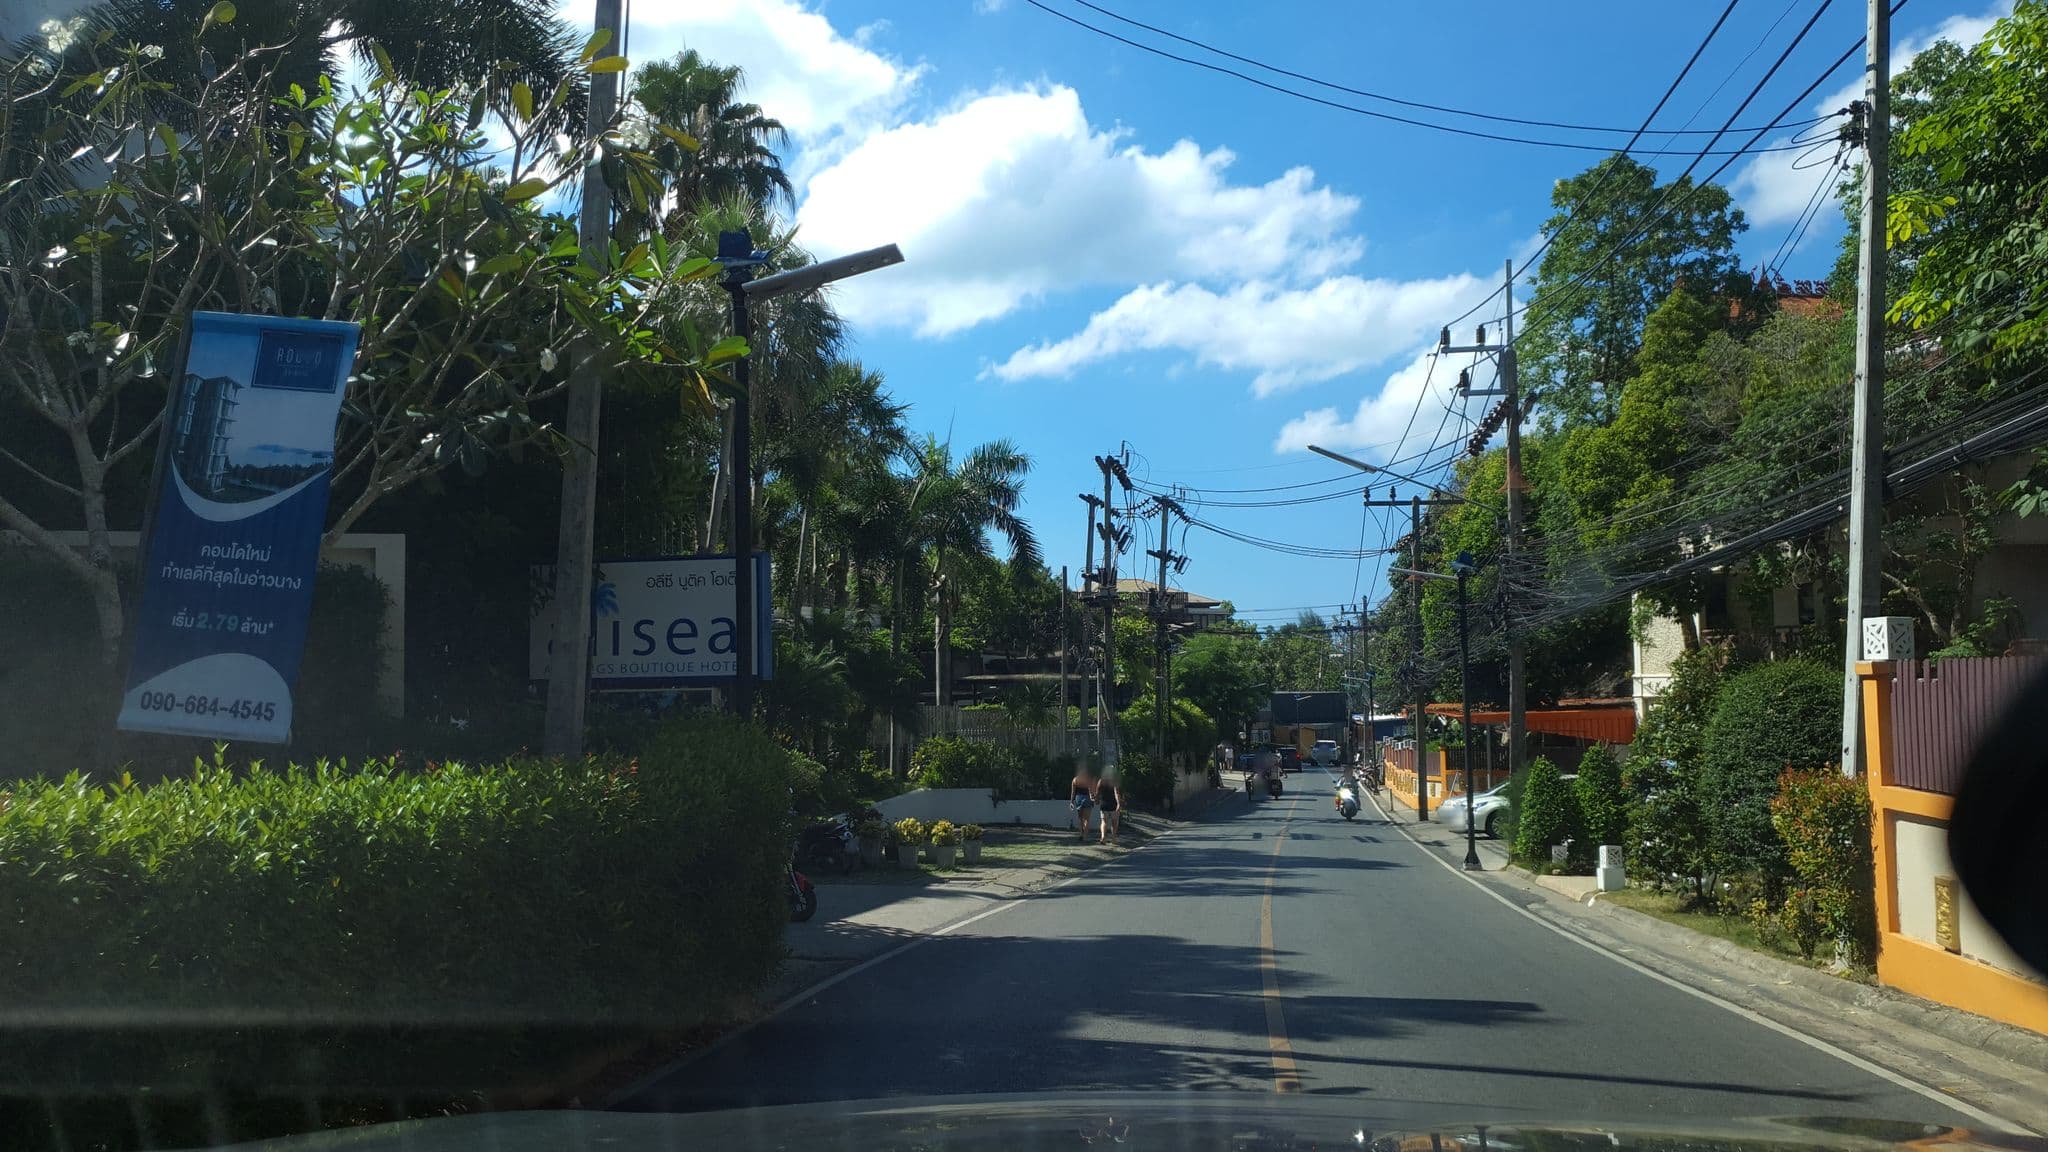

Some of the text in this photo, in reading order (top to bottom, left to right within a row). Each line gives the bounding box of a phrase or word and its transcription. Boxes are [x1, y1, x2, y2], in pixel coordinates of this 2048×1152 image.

[201, 542, 272, 562] คอนโดใหม่
[162, 561, 302, 589] ทำเลดีที่สุดในอ่าวนาง
[171, 607, 194, 628] เริ่ม
[196, 612, 239, 632] 2.79
[620, 661, 694, 674] BOUTIQUE
[700, 661, 737, 672] HOTE
[140, 691, 276, 722] 090-684-4545
